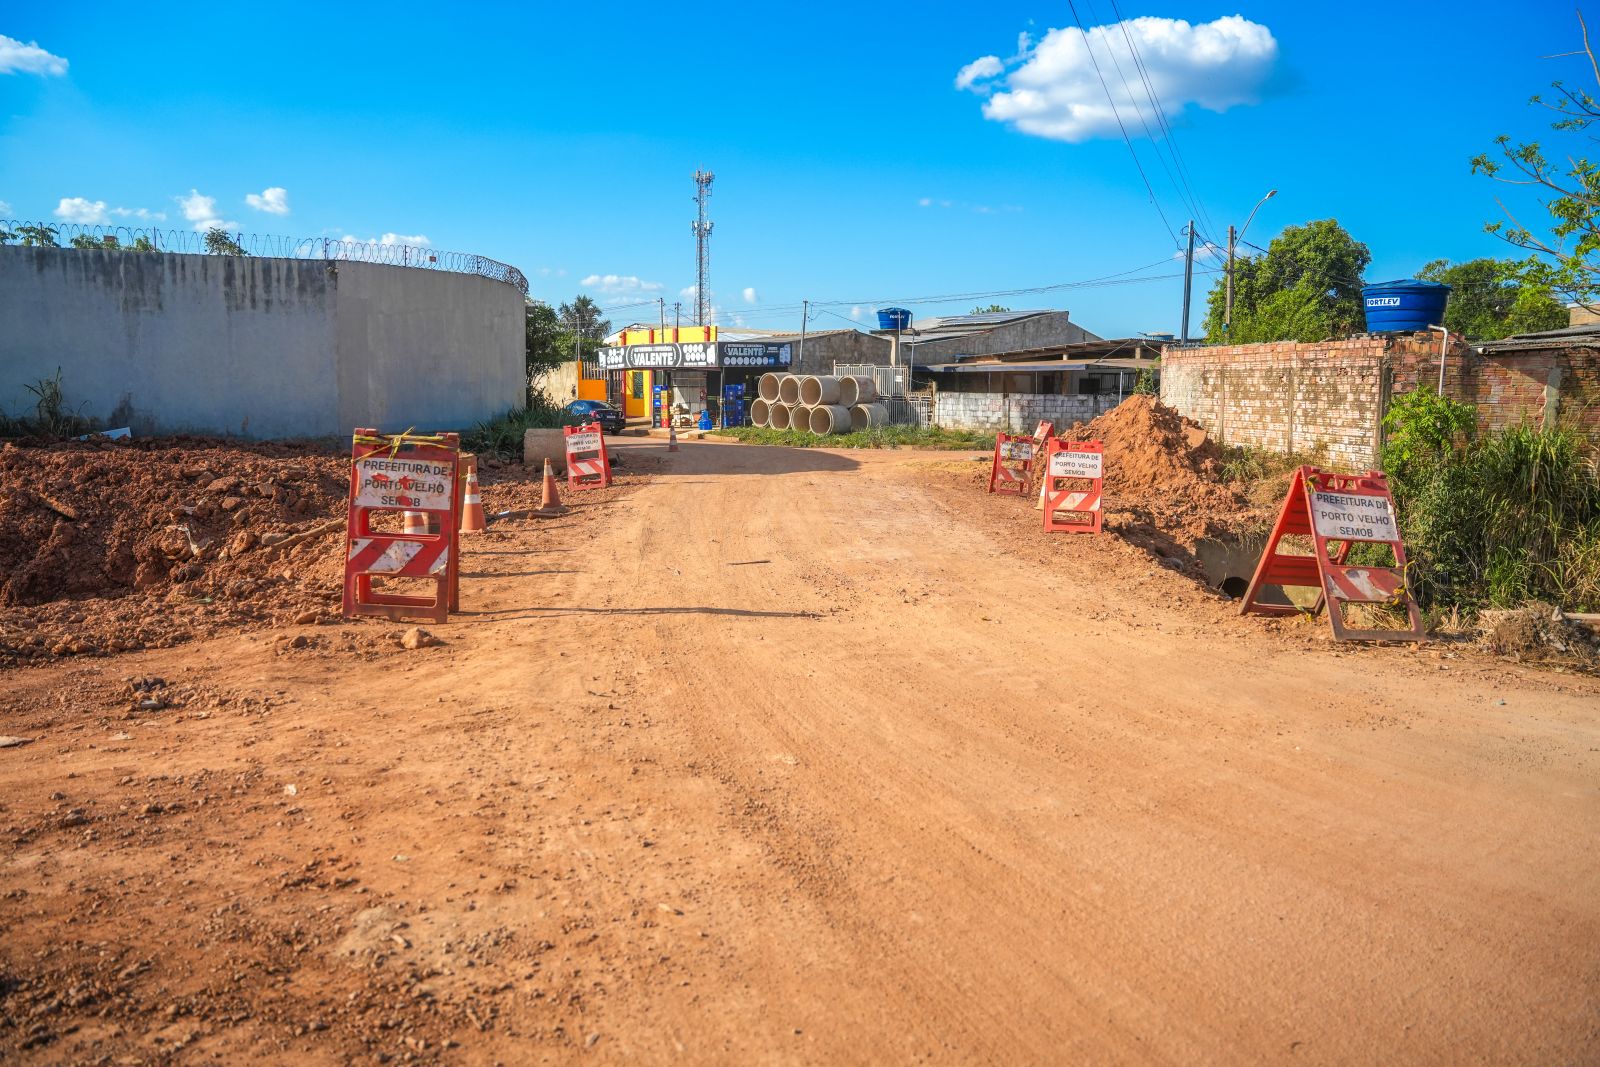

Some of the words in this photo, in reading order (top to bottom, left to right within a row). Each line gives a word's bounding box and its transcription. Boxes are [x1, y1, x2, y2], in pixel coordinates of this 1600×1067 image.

[727, 347, 764, 356] VALENTE
[633, 352, 674, 366] VALENTE
[363, 460, 431, 474] PREFEITURA
[433, 466, 448, 476] DE
[1077, 462, 1098, 470] VELHO
[408, 480, 445, 494] VELHO
[1316, 493, 1374, 508] PREFEITURA
[1321, 511, 1354, 522] PORTO
[1357, 514, 1390, 526] VELHO
[1339, 526, 1374, 538] SEMOB
